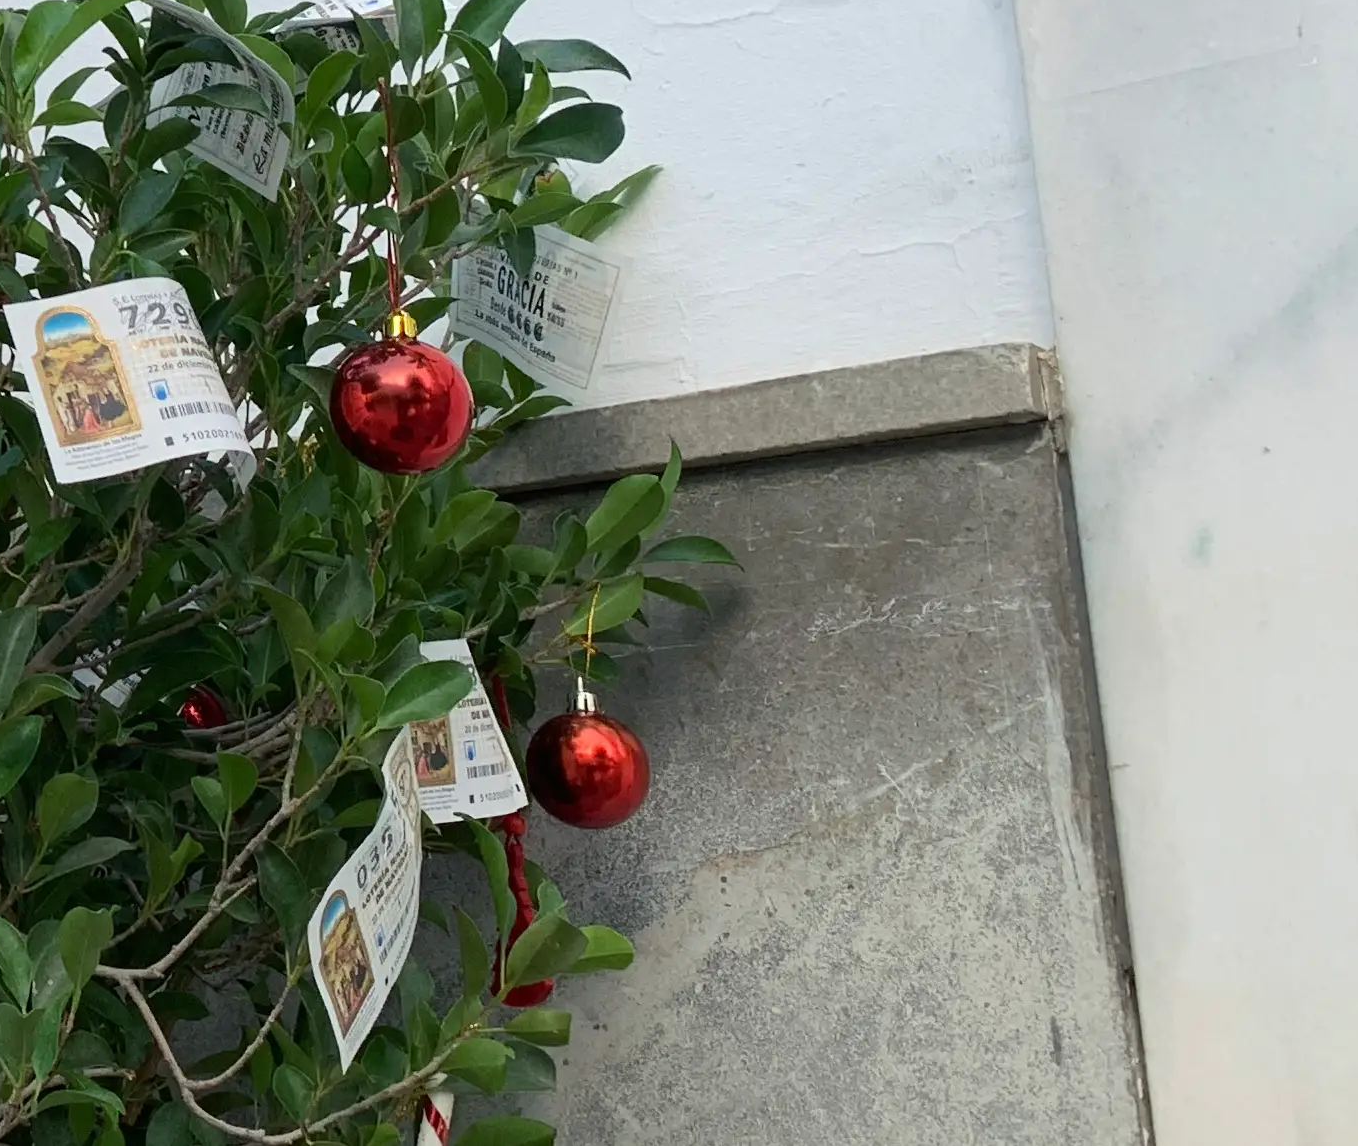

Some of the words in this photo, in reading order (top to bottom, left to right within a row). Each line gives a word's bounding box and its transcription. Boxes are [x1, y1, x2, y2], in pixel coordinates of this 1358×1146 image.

[534, 271, 549, 285] DE
[497, 265, 546, 319] GRACIA
[147, 365, 160, 373] 22
[162, 361, 174, 371] de
